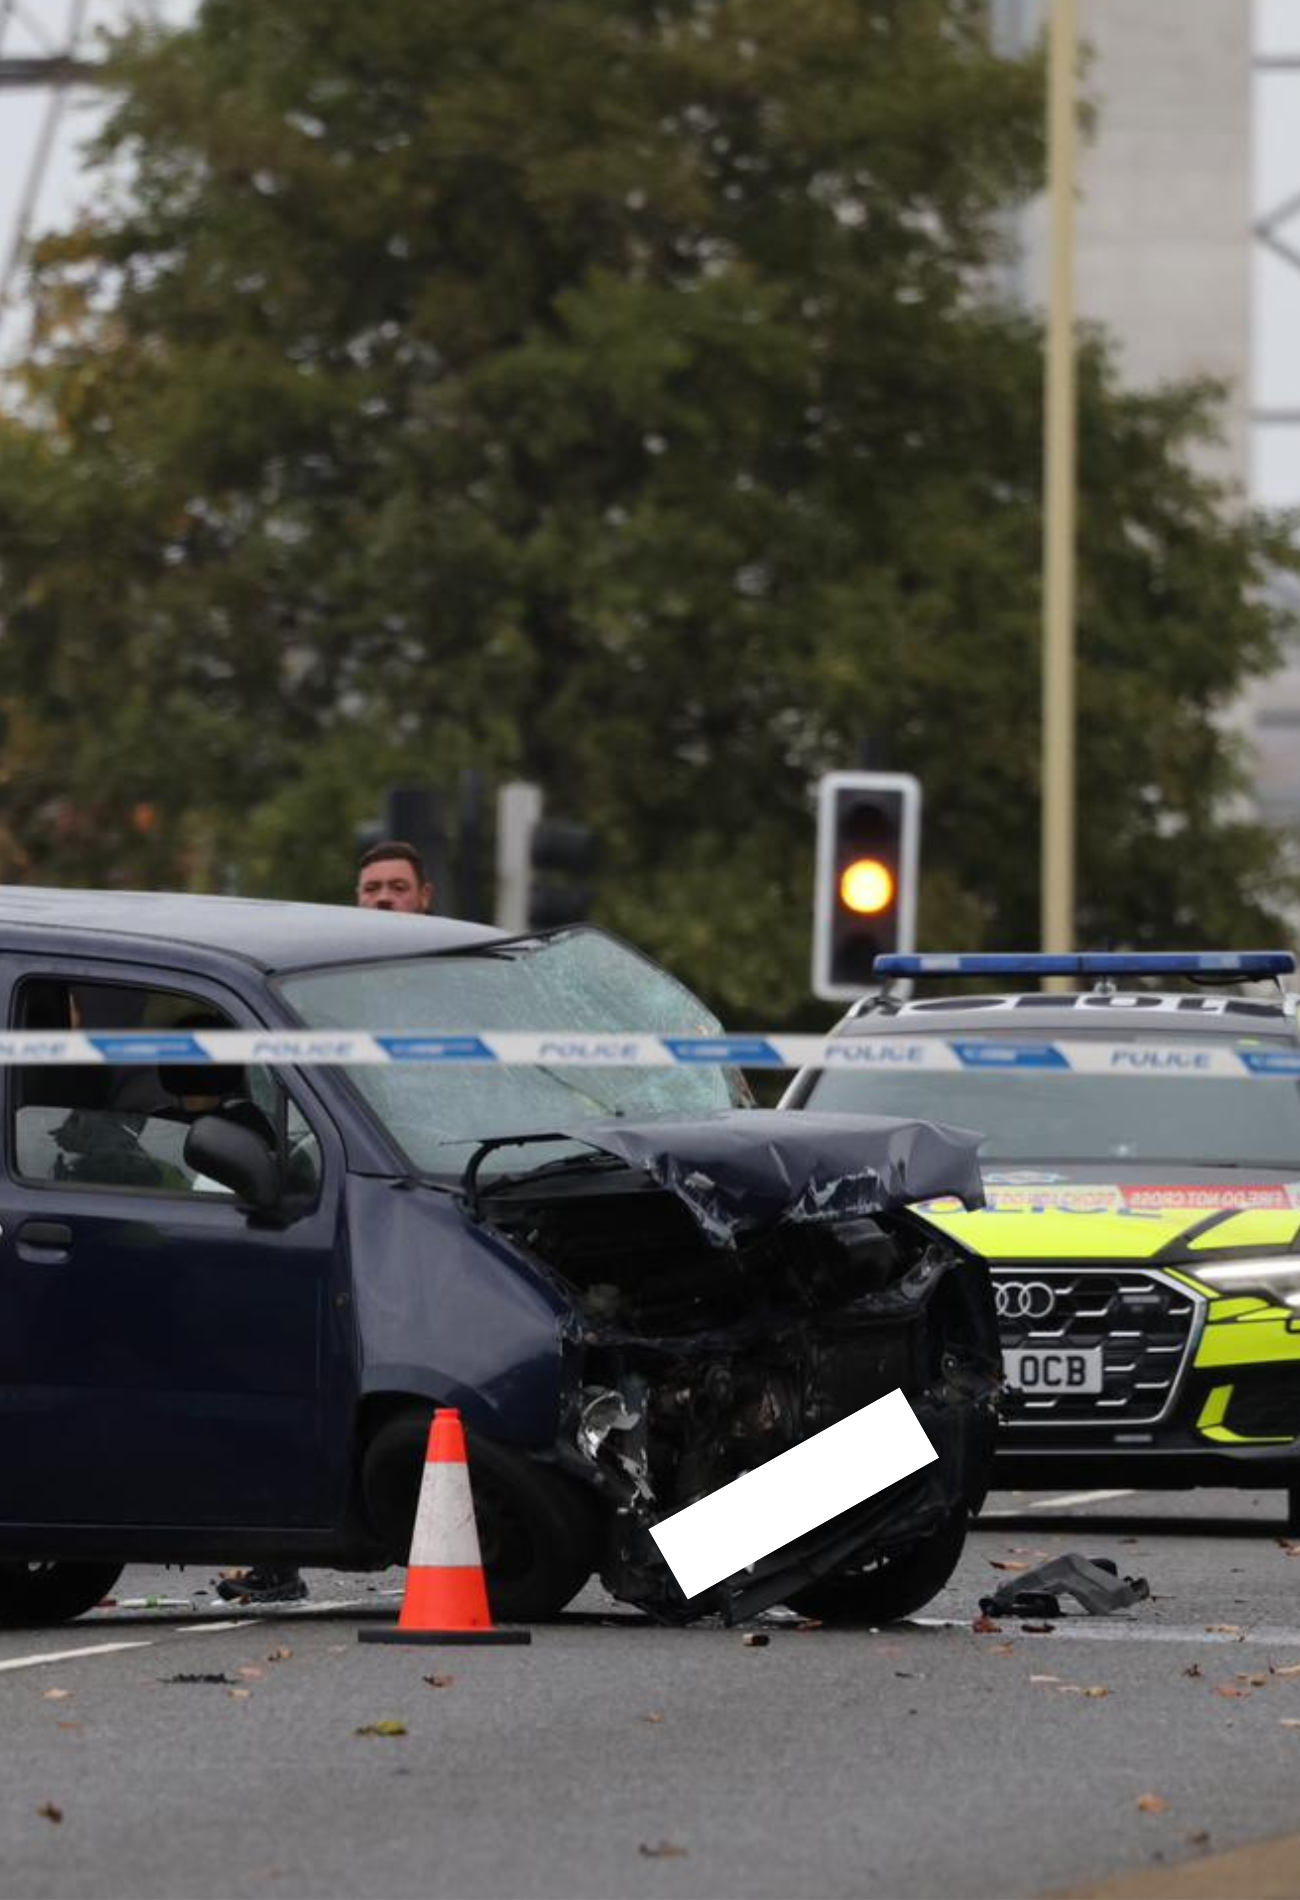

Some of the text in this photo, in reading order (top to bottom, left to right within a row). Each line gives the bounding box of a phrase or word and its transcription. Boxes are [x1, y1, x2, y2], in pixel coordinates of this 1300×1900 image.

[252, 1041, 354, 1058] POLICE
[538, 1042, 639, 1059] POLICE
[824, 1043, 923, 1063] POLICE
[1109, 1048, 1211, 1069] POLICE
[1020, 1355, 1087, 1387] OCB
